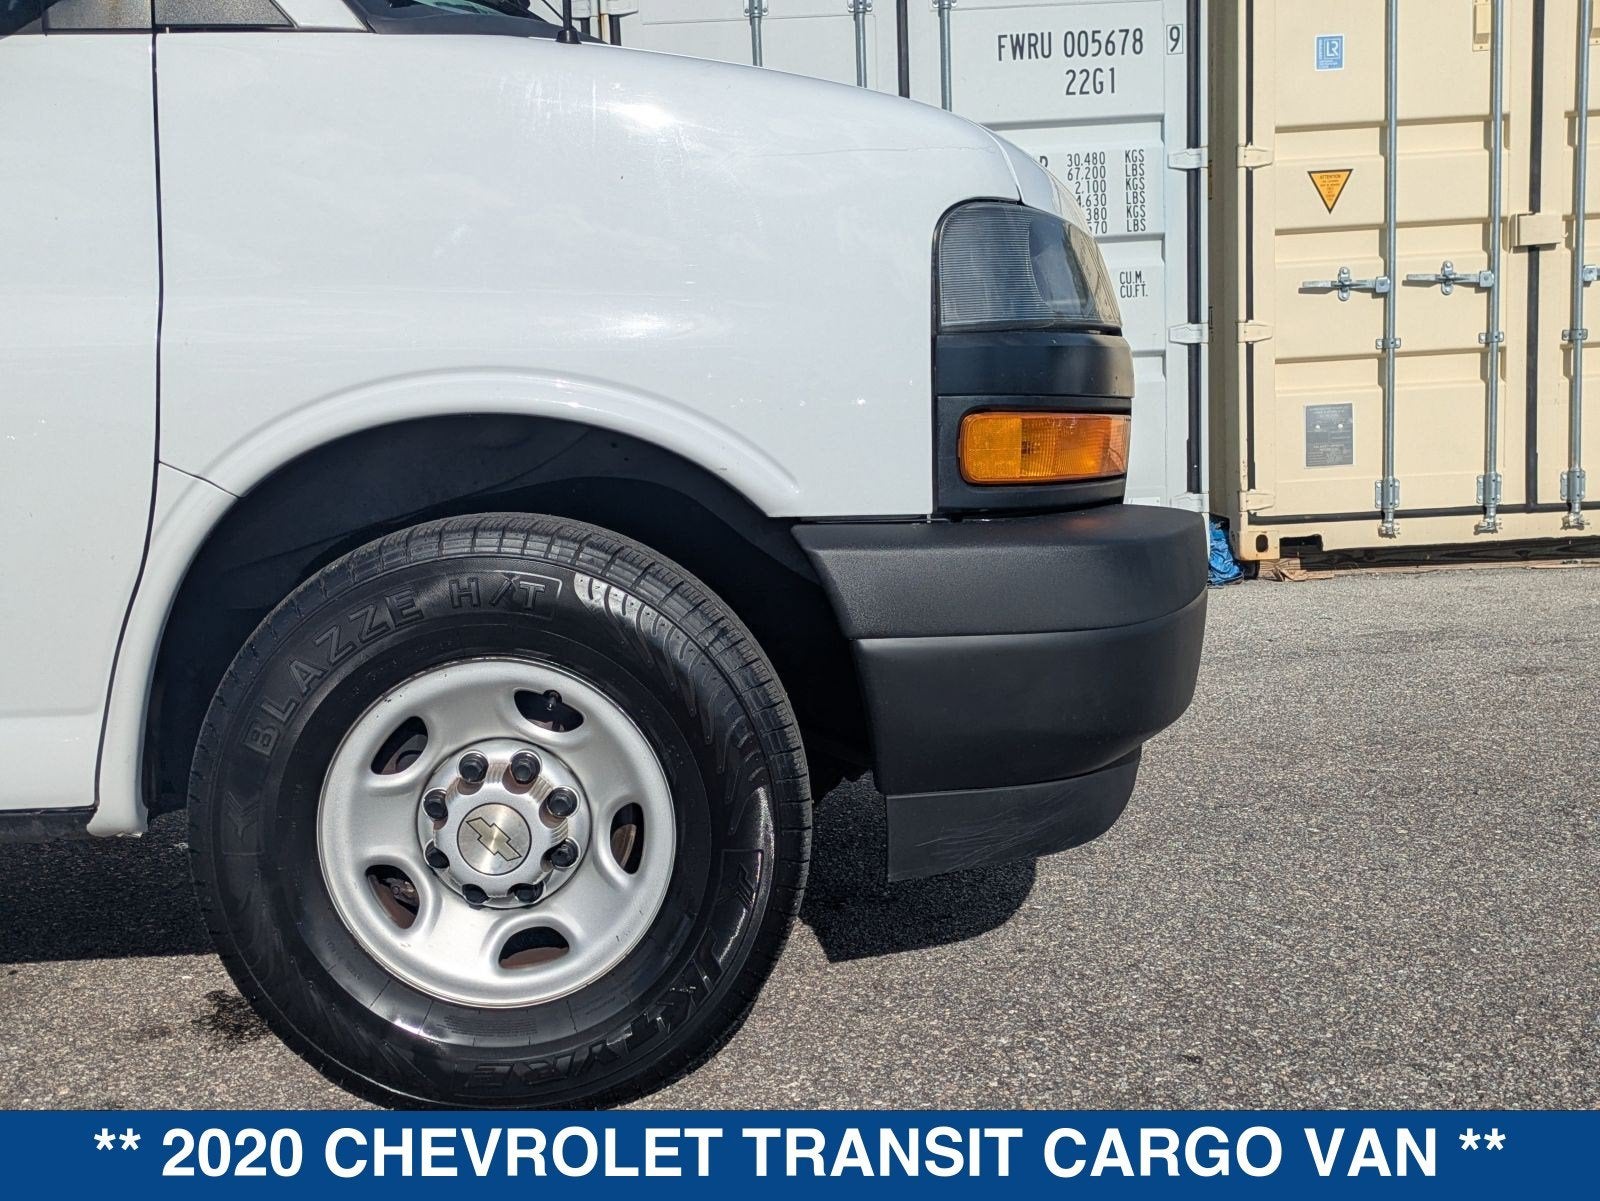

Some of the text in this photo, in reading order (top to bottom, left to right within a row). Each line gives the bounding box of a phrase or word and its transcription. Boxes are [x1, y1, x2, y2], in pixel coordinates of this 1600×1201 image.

[997, 26, 1181, 61] FWRU 005678 9
[1065, 67, 1115, 96] 22G1
[1066, 151, 1106, 168] 30.480
[1124, 149, 1145, 164] KGS
[1067, 163, 1145, 182] 67.200 LBS
[1075, 177, 1146, 195] 2.100 KGS
[1126, 191, 1146, 205] LBS
[1126, 204, 1147, 219] KGS
[1126, 218, 1147, 233] LBS
[1119, 271, 1145, 286] CU.M.
[1120, 284, 1149, 299] CU.FT.
[245, 575, 547, 757] BLAZZE H/T
[463, 1012, 662, 1091] TYRE
